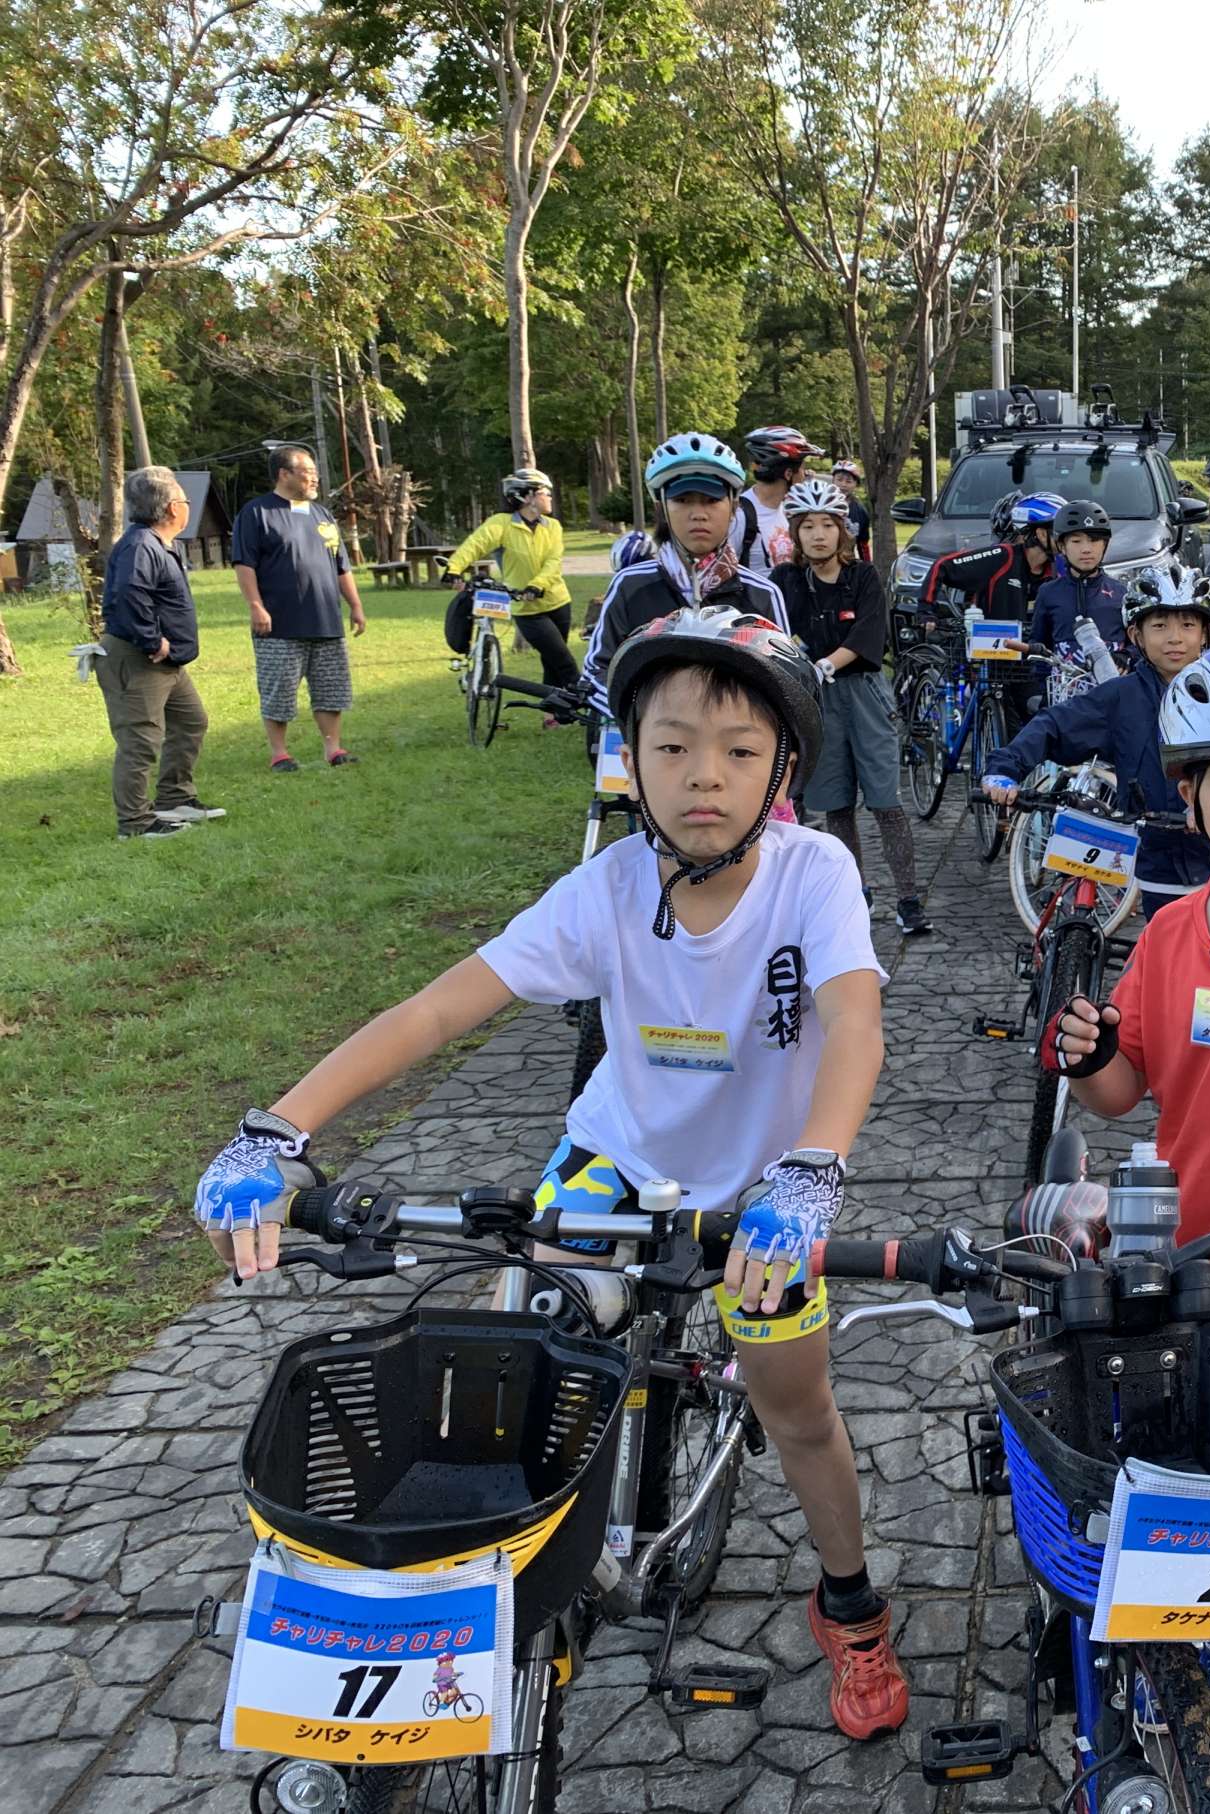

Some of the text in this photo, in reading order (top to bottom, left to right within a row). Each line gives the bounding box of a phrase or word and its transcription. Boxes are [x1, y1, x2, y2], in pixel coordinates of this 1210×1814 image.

[952, 547, 1002, 565] UMBRO
[992, 639, 1001, 649] 4
[1083, 848, 1101, 864] 9
[647, 1029, 720, 1042] チャリチャレ 2020
[631, 1320, 642, 1329] 22
[800, 1308, 825, 1331] CHE
[270, 1617, 474, 1653] チャリチャレ2020
[332, 1665, 403, 1719] 17
[295, 1723, 431, 1745] シバタ ケイジ
